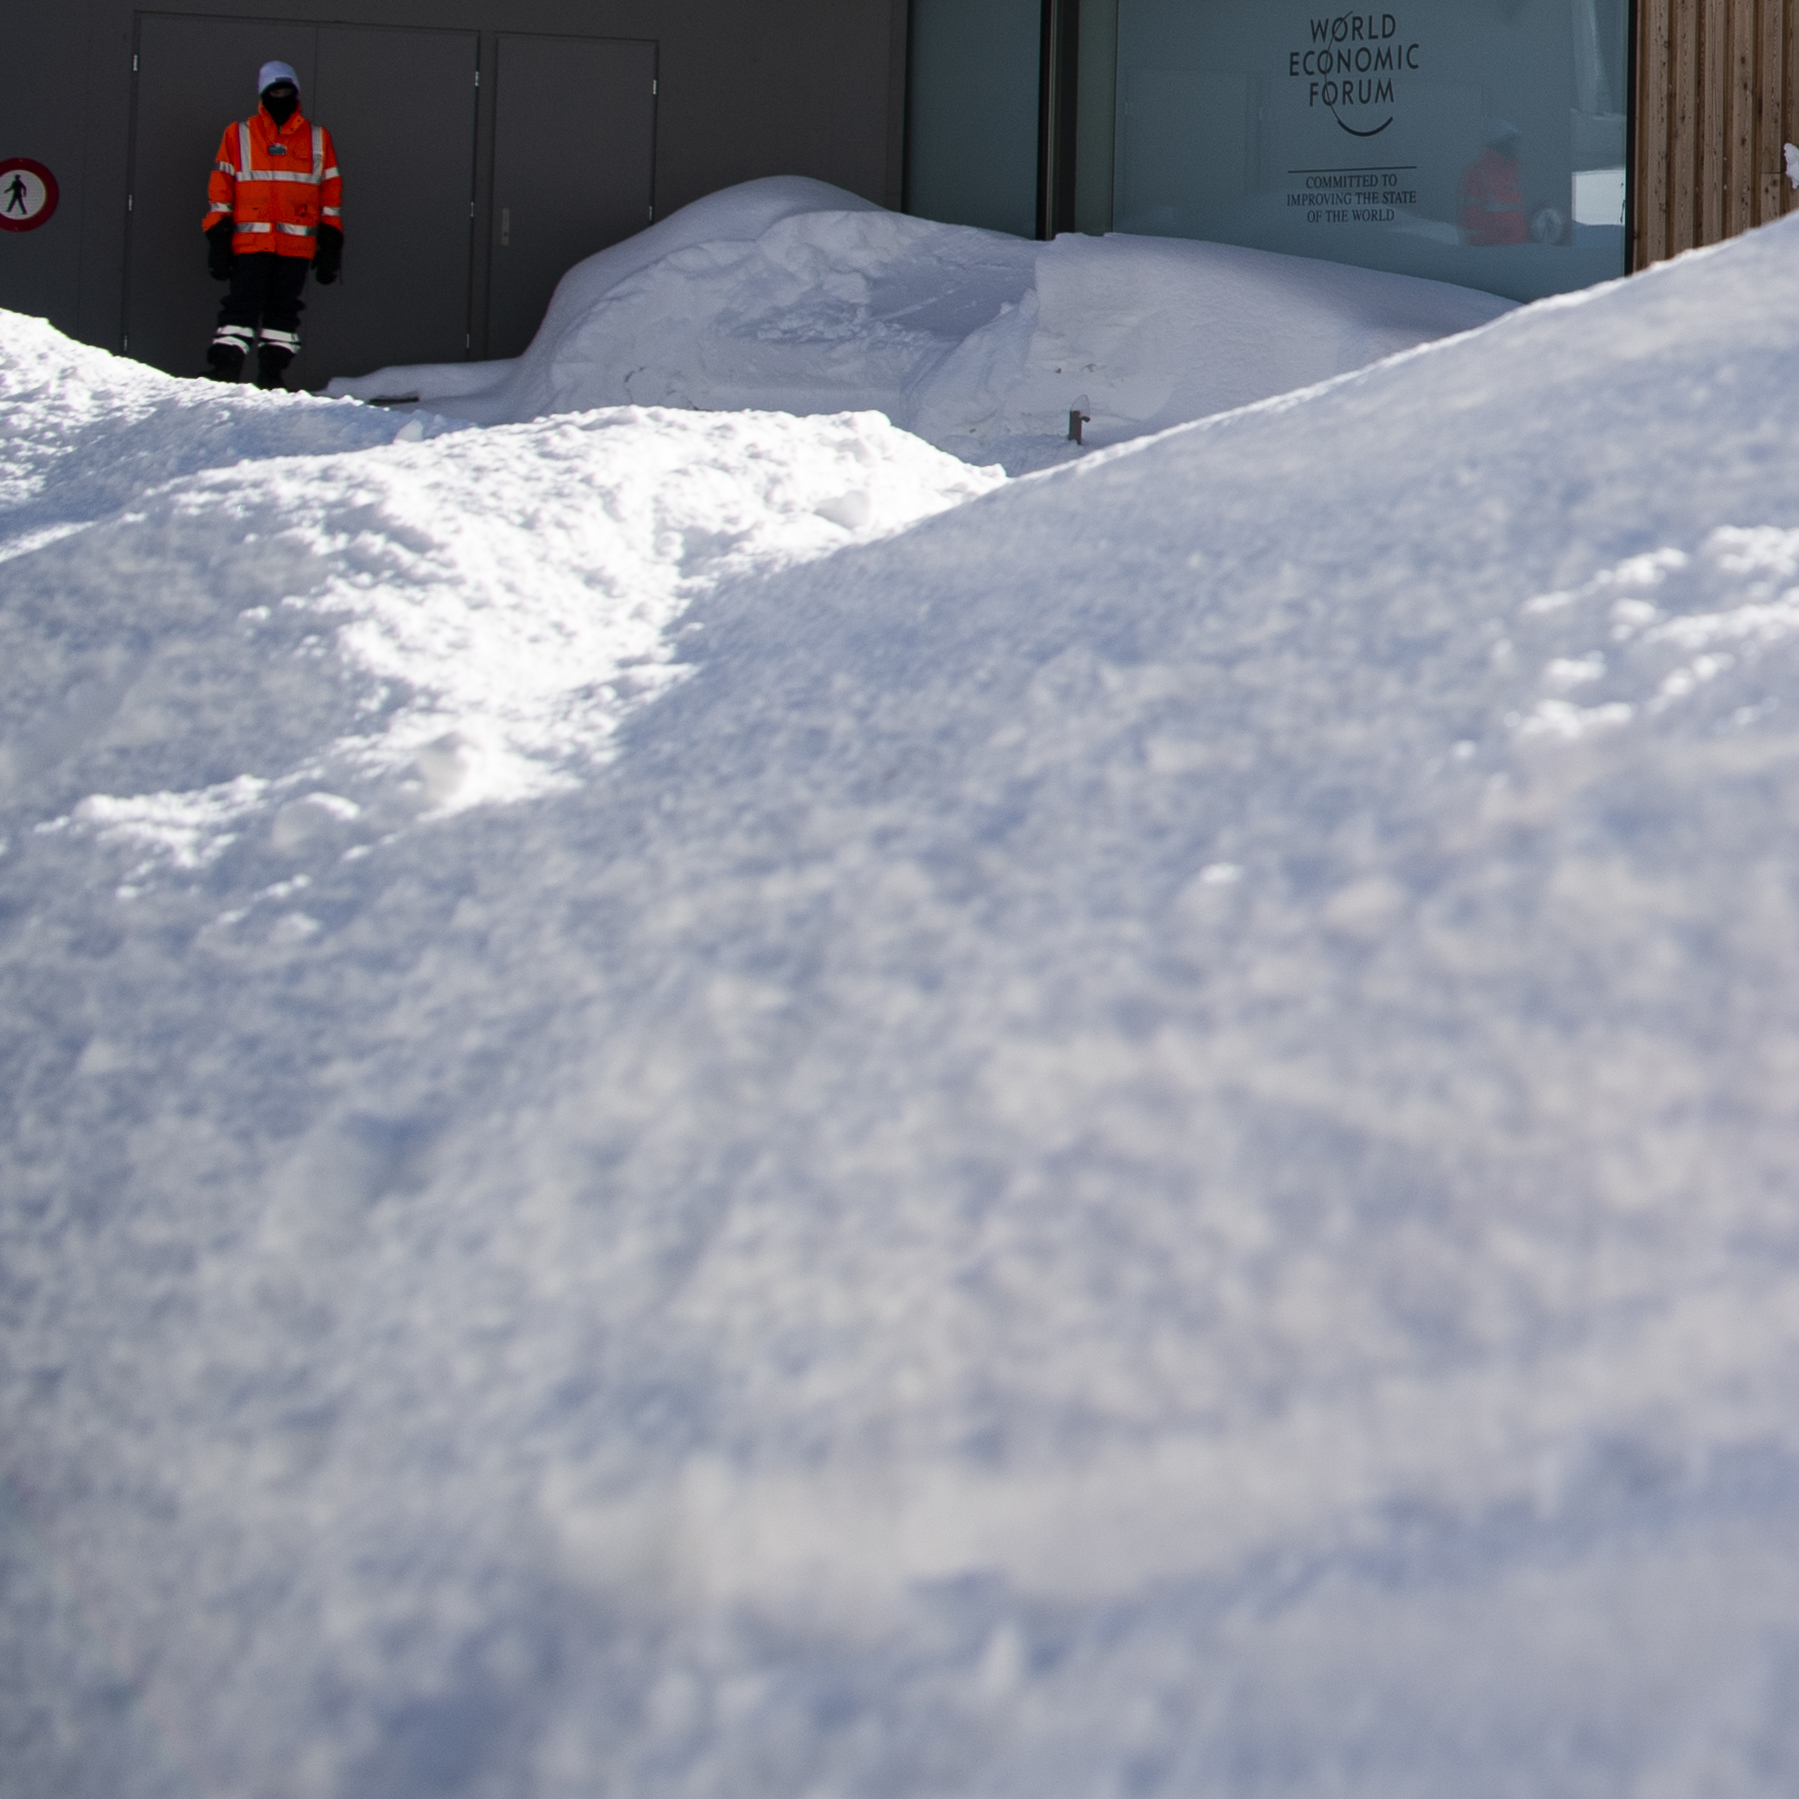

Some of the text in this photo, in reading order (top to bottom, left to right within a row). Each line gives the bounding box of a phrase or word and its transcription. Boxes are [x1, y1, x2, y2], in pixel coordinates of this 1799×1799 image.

[1310, 14, 1396, 44] WORLD
[1289, 43, 1419, 76] ECONOMIC
[1309, 78, 1395, 107] FORUM
[1306, 173, 1398, 189] COMMITTED TO
[1287, 191, 1417, 207] IMPROVING THE STATE
[1307, 208, 1395, 223] OF THE WORLD
